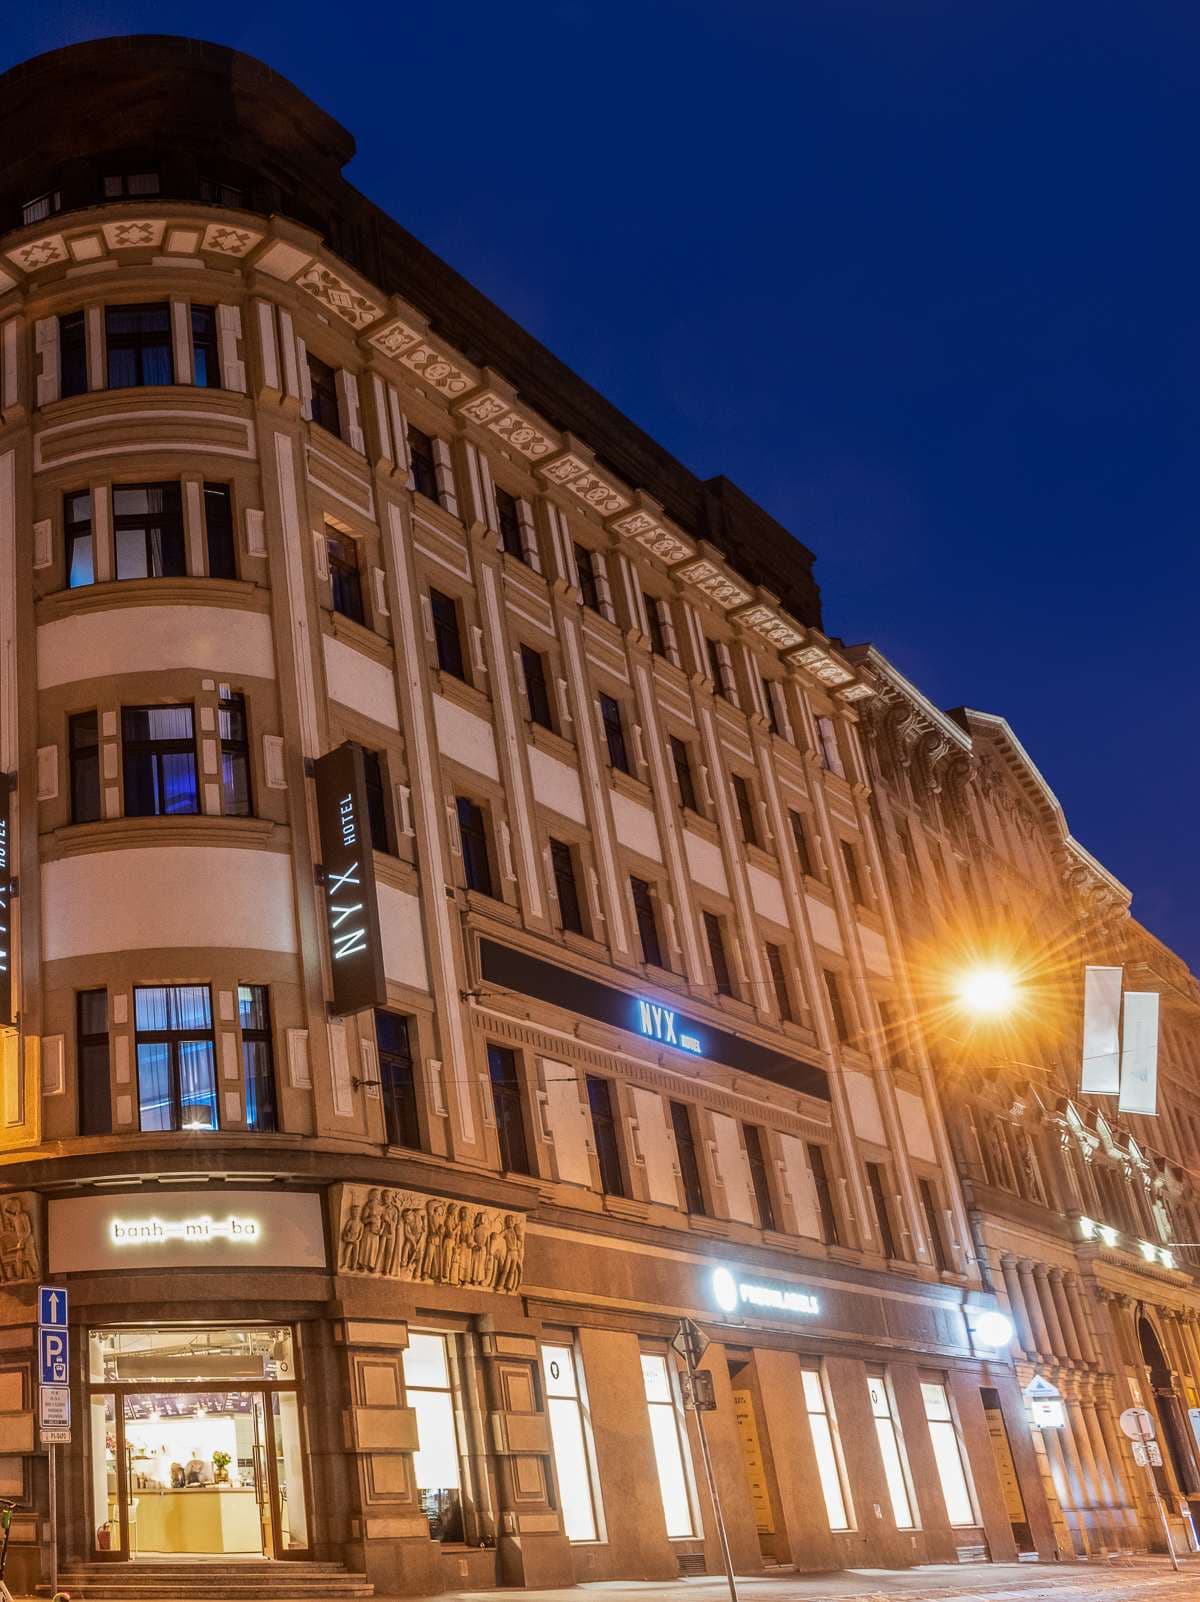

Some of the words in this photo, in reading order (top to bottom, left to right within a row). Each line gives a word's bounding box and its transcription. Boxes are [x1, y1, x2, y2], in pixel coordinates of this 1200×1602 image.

[339, 793, 357, 846] HOTEL
[328, 861, 367, 960] NYX
[640, 1000, 677, 1045] NYX
[46, 1335, 63, 1368] P
